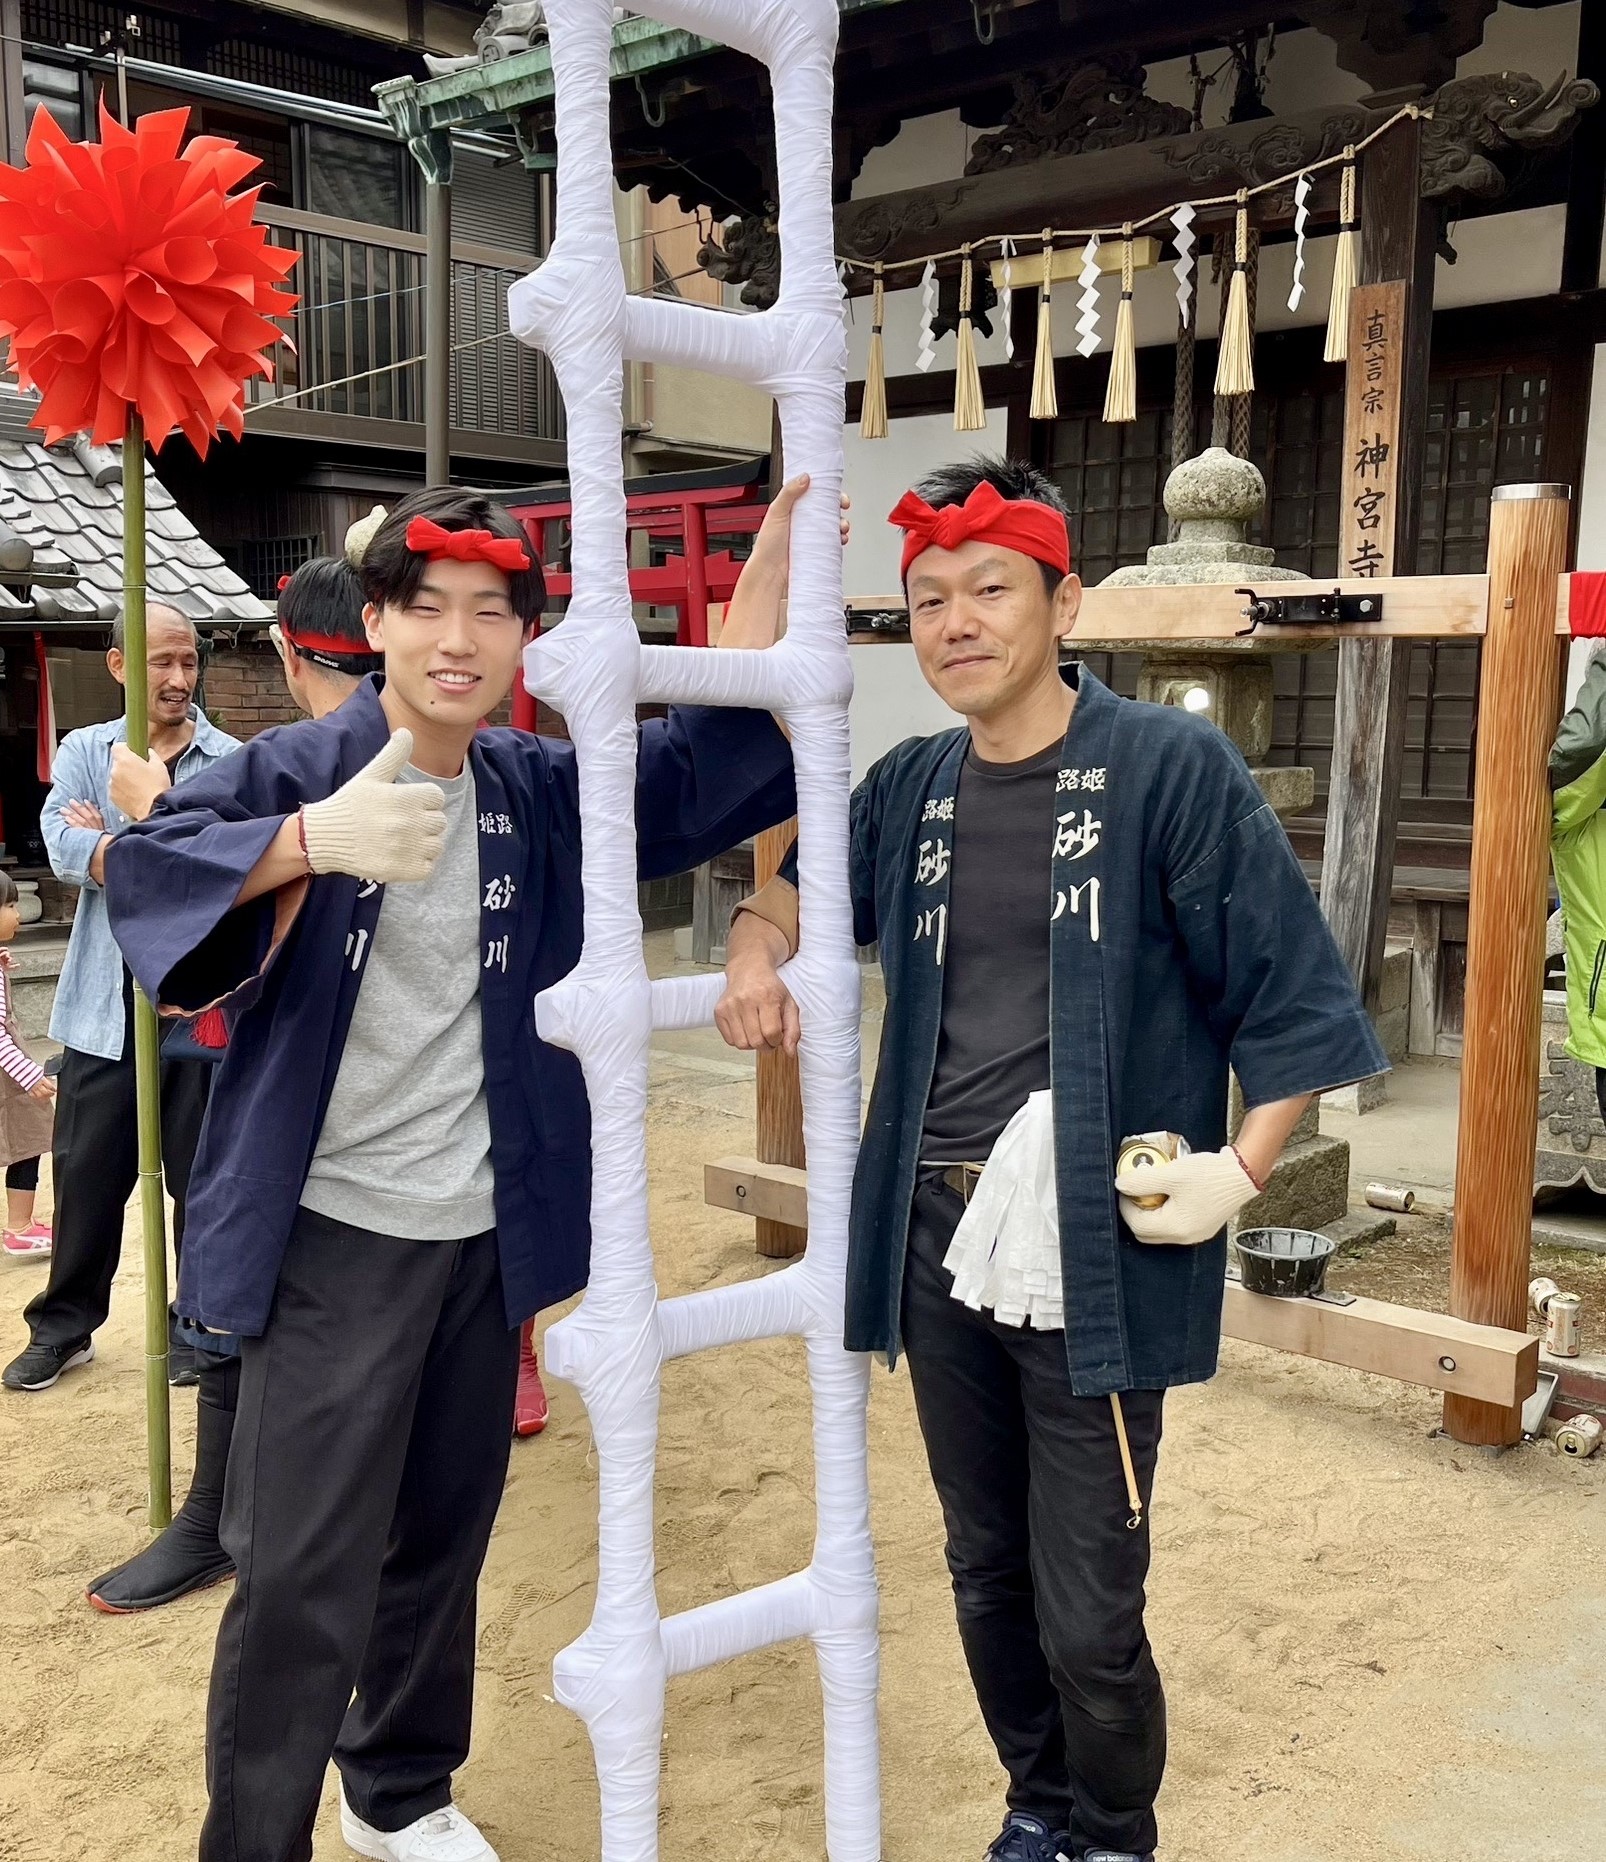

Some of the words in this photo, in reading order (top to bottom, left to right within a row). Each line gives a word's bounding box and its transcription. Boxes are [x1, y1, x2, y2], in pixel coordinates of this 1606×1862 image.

[1360, 309, 1389, 414] 真言宗
[1348, 432, 1390, 578] 神宮寺
[478, 812, 513, 834] 姫路
[1051, 809, 1102, 942] 砂川
[482, 874, 516, 973] 砂川
[913, 838, 952, 966] 砂川
